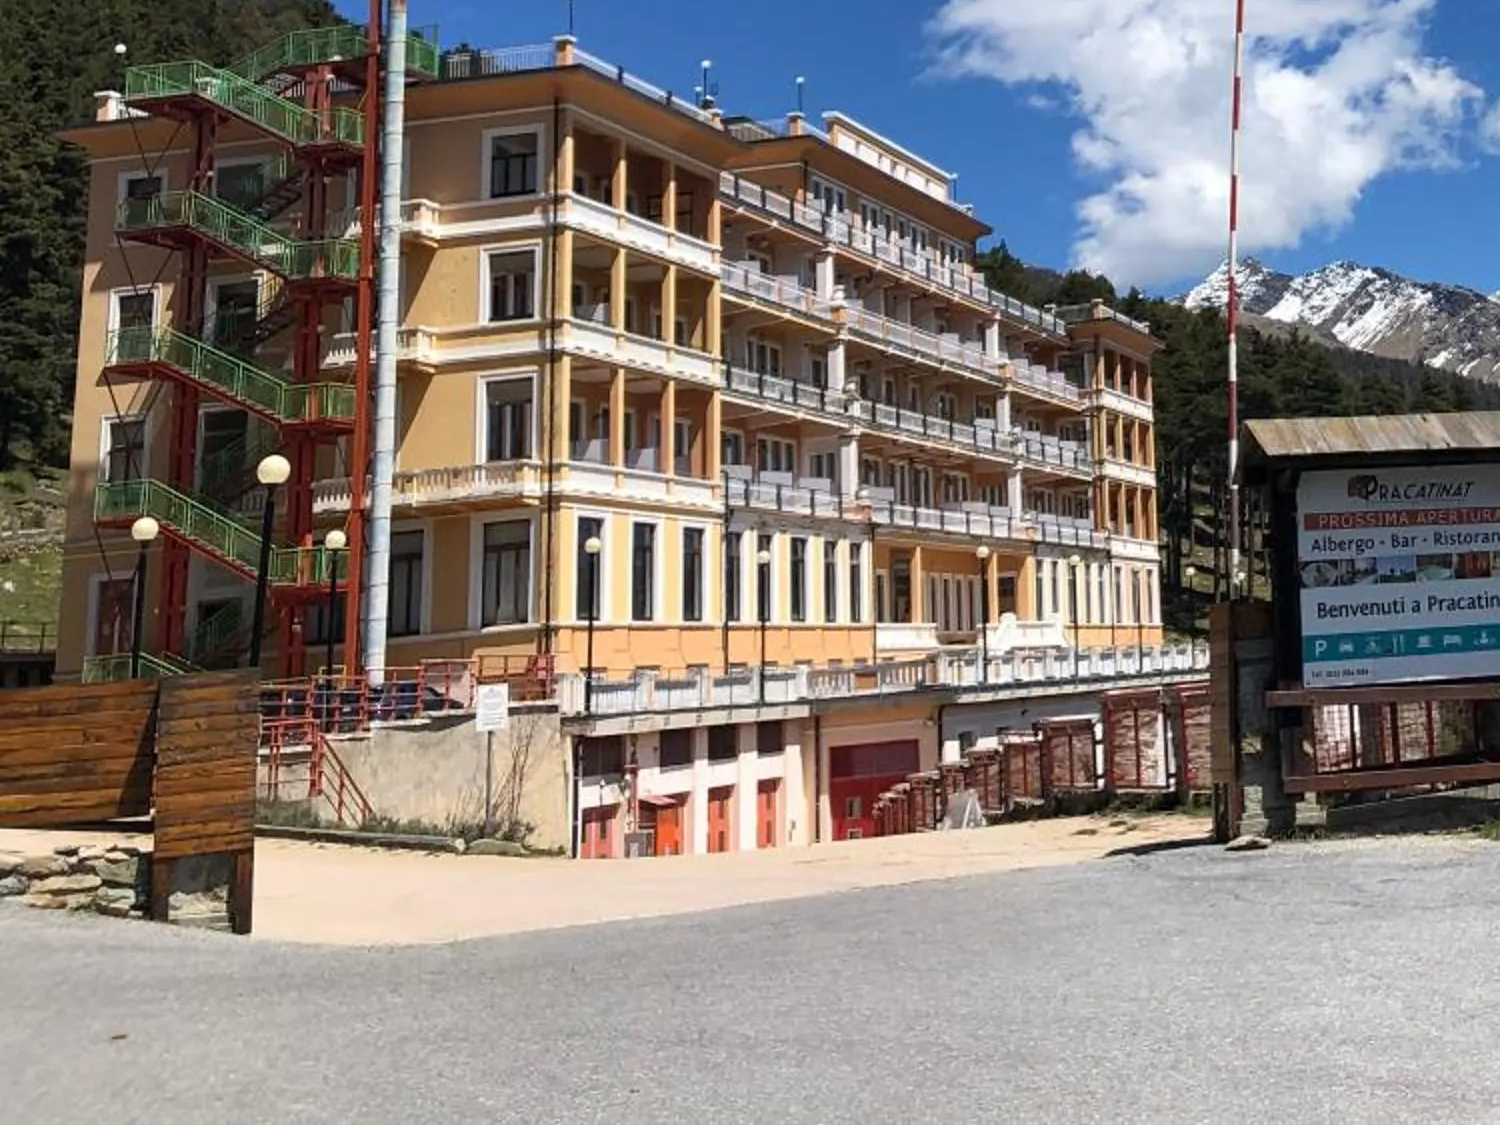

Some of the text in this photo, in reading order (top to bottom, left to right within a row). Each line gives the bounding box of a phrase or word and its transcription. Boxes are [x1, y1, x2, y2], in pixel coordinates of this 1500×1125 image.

[1319, 513, 1410, 528] PROSSIMA
[1311, 536, 1375, 555] Albergo
[1391, 534, 1417, 548] Bar
[1317, 597, 1405, 618] Benvenuti
[1411, 600, 1421, 613] a
[1315, 640, 1327, 656] P
